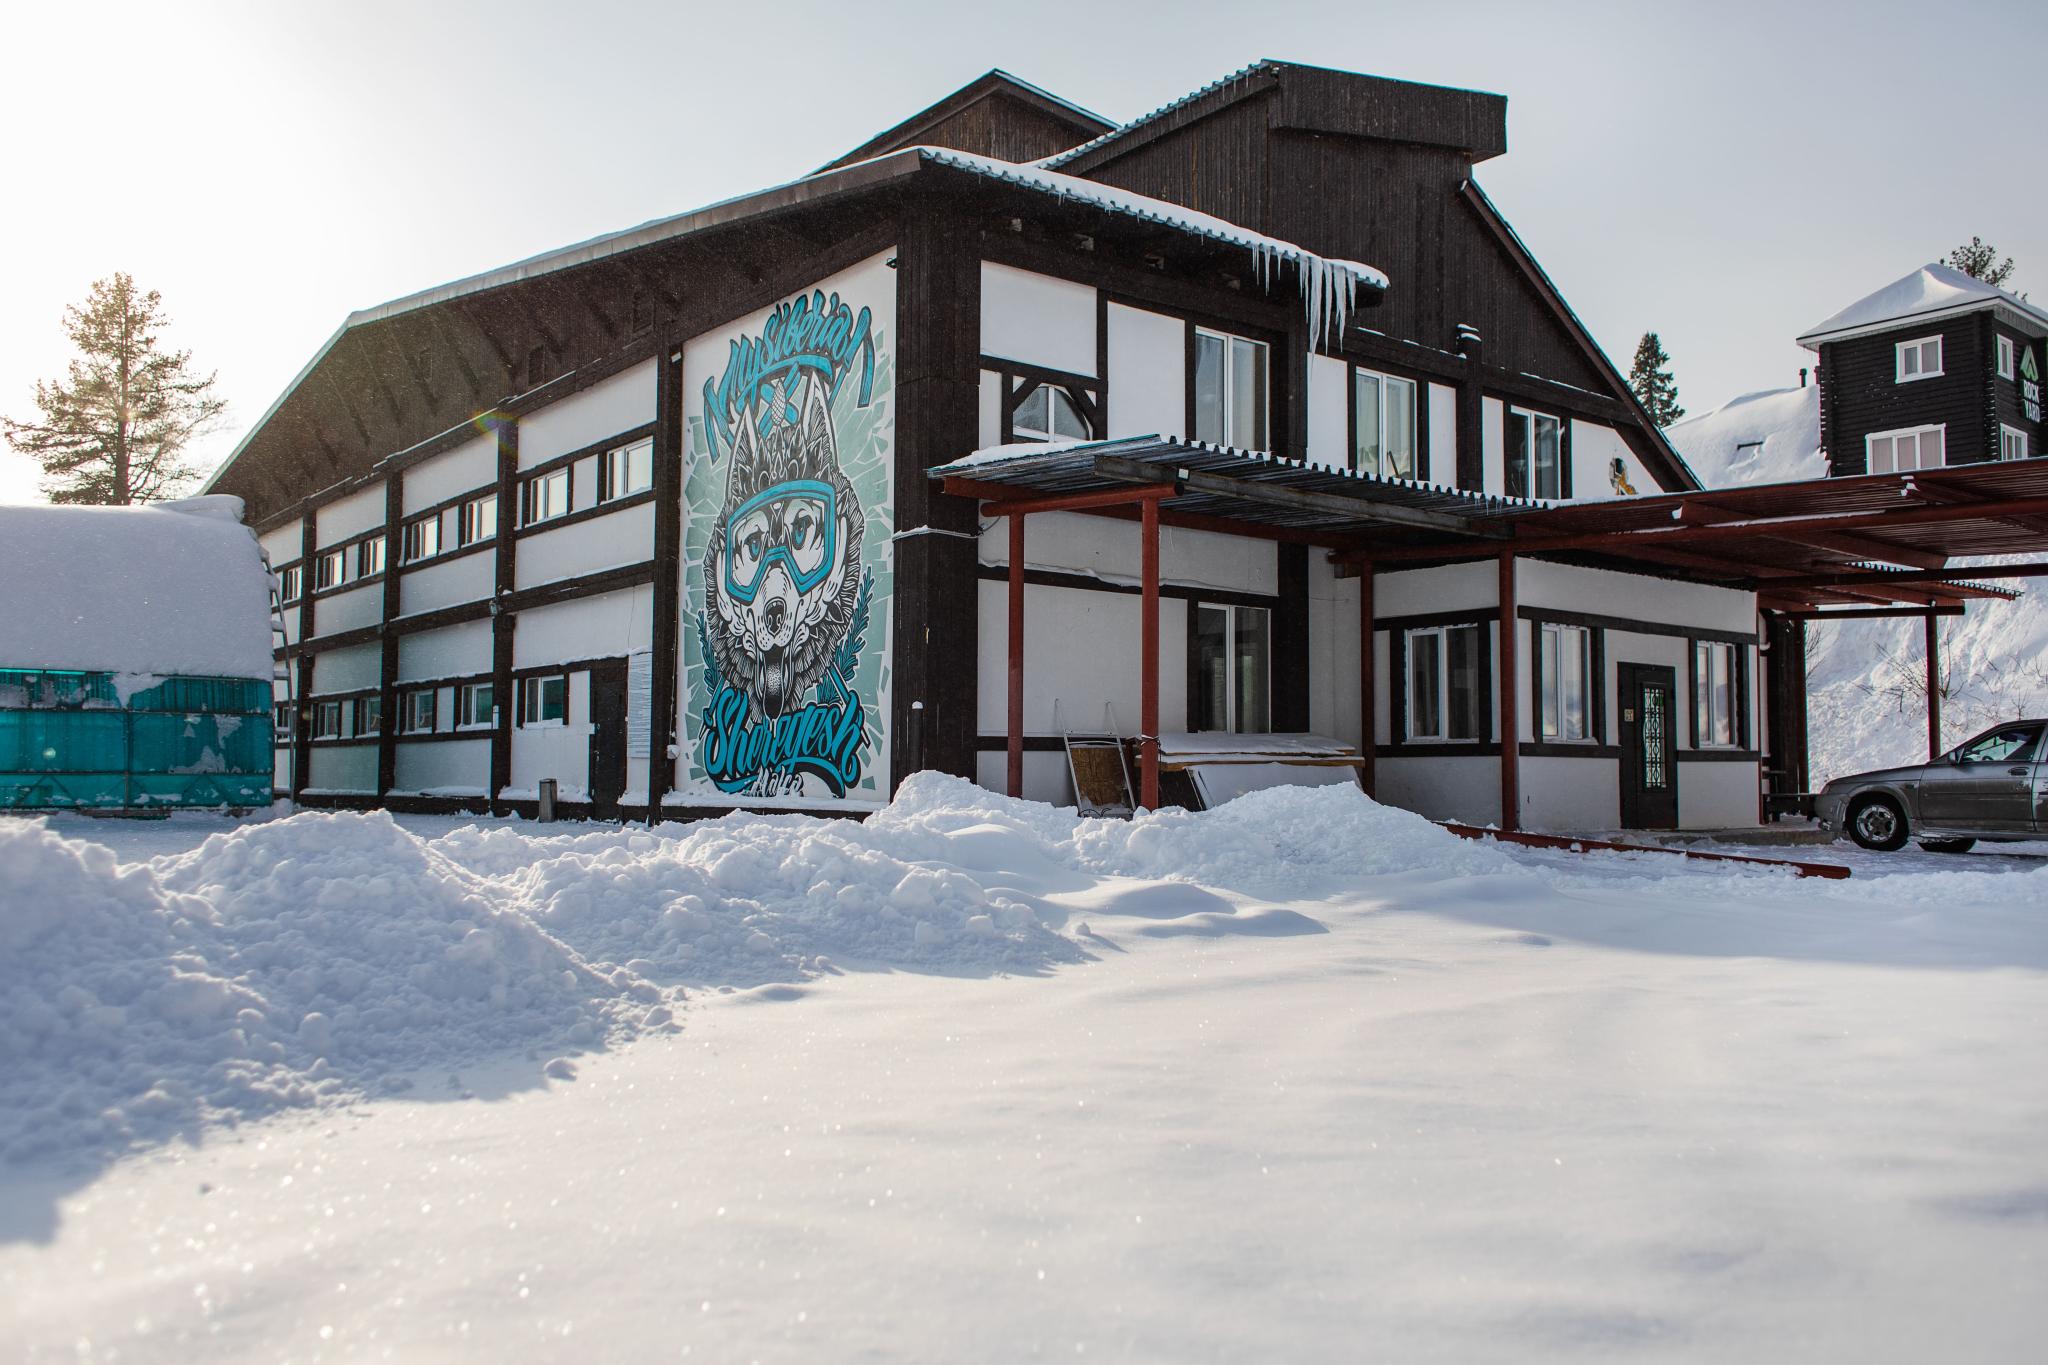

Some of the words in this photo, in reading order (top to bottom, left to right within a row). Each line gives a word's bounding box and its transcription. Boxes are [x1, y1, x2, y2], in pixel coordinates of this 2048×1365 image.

[2023, 379, 2040, 404] ROCK
[2023, 398, 2041, 423] YARD
[704, 686, 865, 792] Sheregesh
